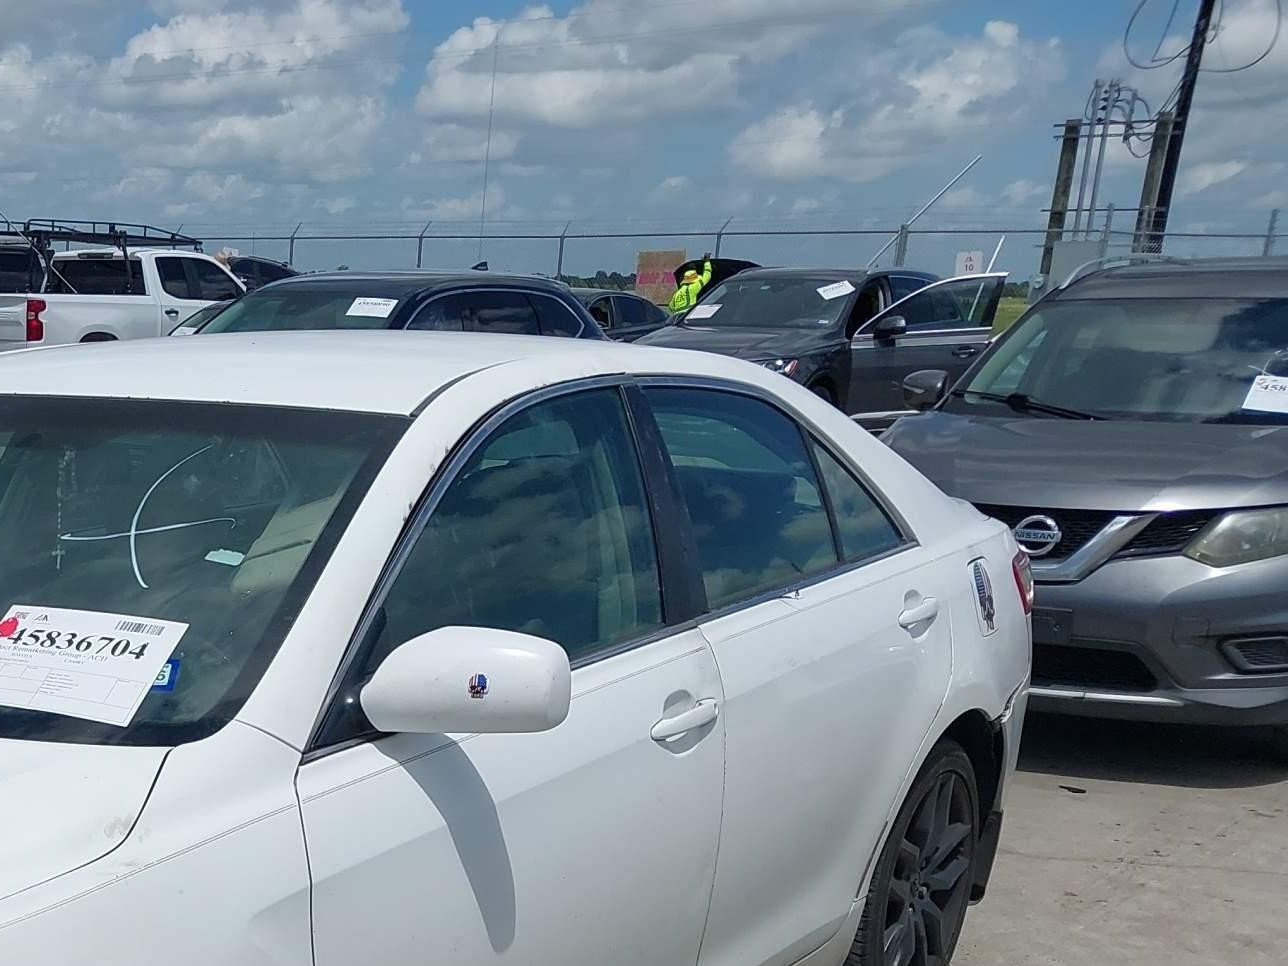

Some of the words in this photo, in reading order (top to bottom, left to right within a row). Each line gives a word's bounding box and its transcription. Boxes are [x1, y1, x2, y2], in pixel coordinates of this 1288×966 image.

[1014, 531, 1056, 541] NISSAN
[6, 627, 150, 660] 45836704
[12, 645, 57, 657] Remarketing
[58, 651, 82, 660] Group
